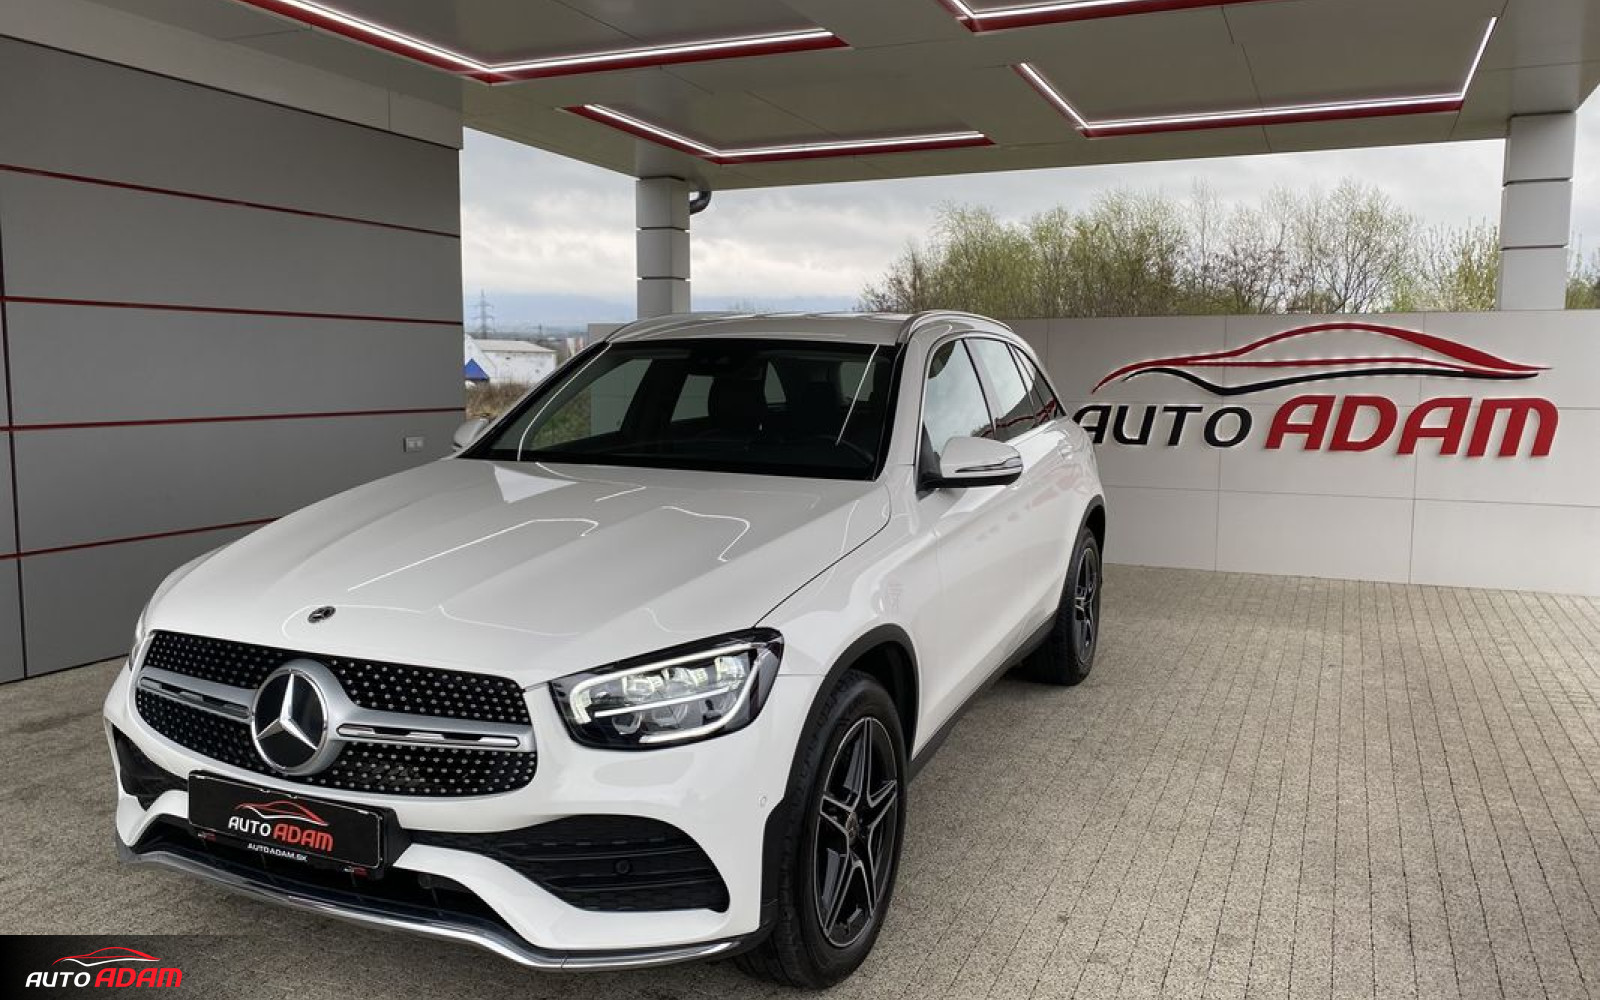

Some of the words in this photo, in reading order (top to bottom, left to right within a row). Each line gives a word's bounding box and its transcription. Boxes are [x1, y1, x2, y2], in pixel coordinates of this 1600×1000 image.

[1072, 404, 1252, 447] AUTO
[1265, 395, 1559, 457] ADAM
[228, 816, 271, 837] AUTO
[273, 823, 334, 852] ADAM
